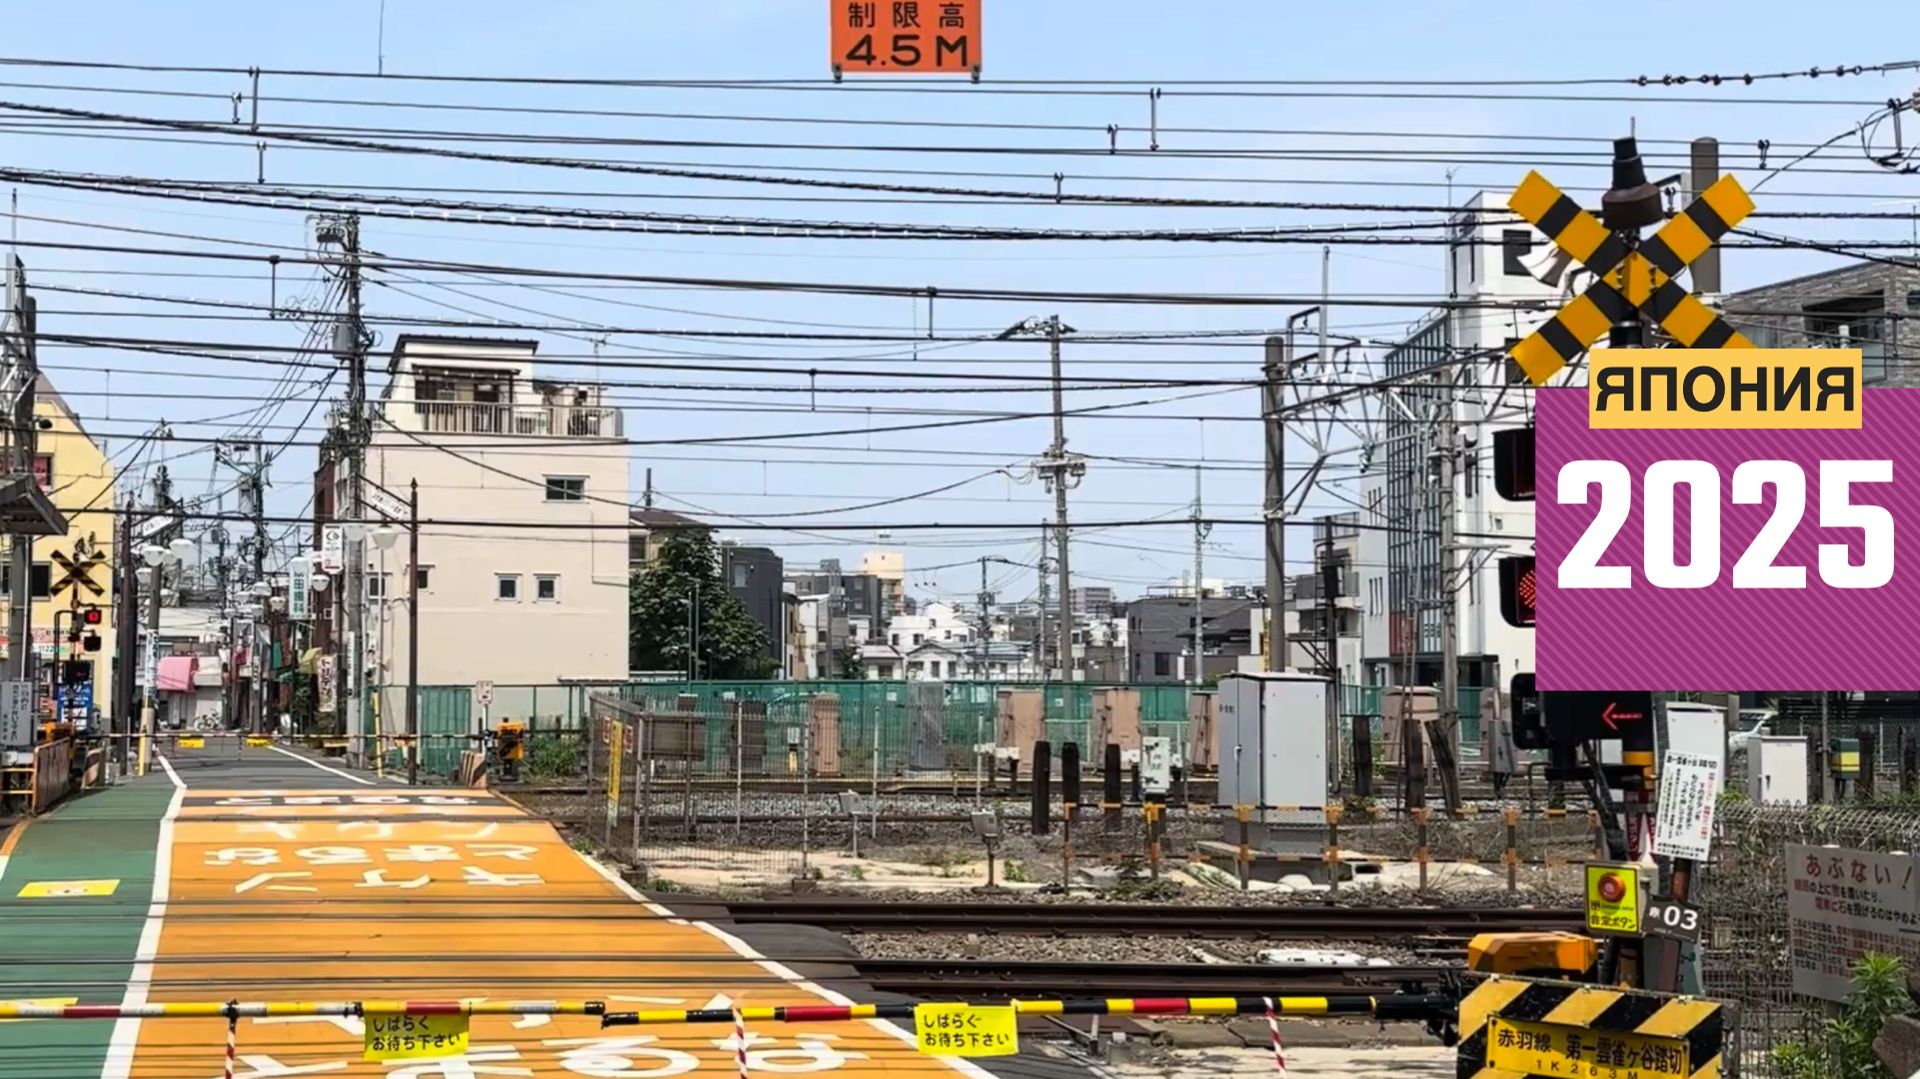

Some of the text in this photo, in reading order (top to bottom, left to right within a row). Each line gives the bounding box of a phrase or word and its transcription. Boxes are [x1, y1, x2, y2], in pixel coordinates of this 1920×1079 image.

[848, 2, 964, 28] 制限高
[1664, 905, 1698, 930] 03
[372, 1015, 430, 1032] しばらく
[924, 1013, 978, 1029] しばらく
[372, 1033, 461, 1052] お待ち下さい
[924, 1032, 1010, 1048] お待ち下さい
[1497, 1029, 1551, 1053] 赤羽線
